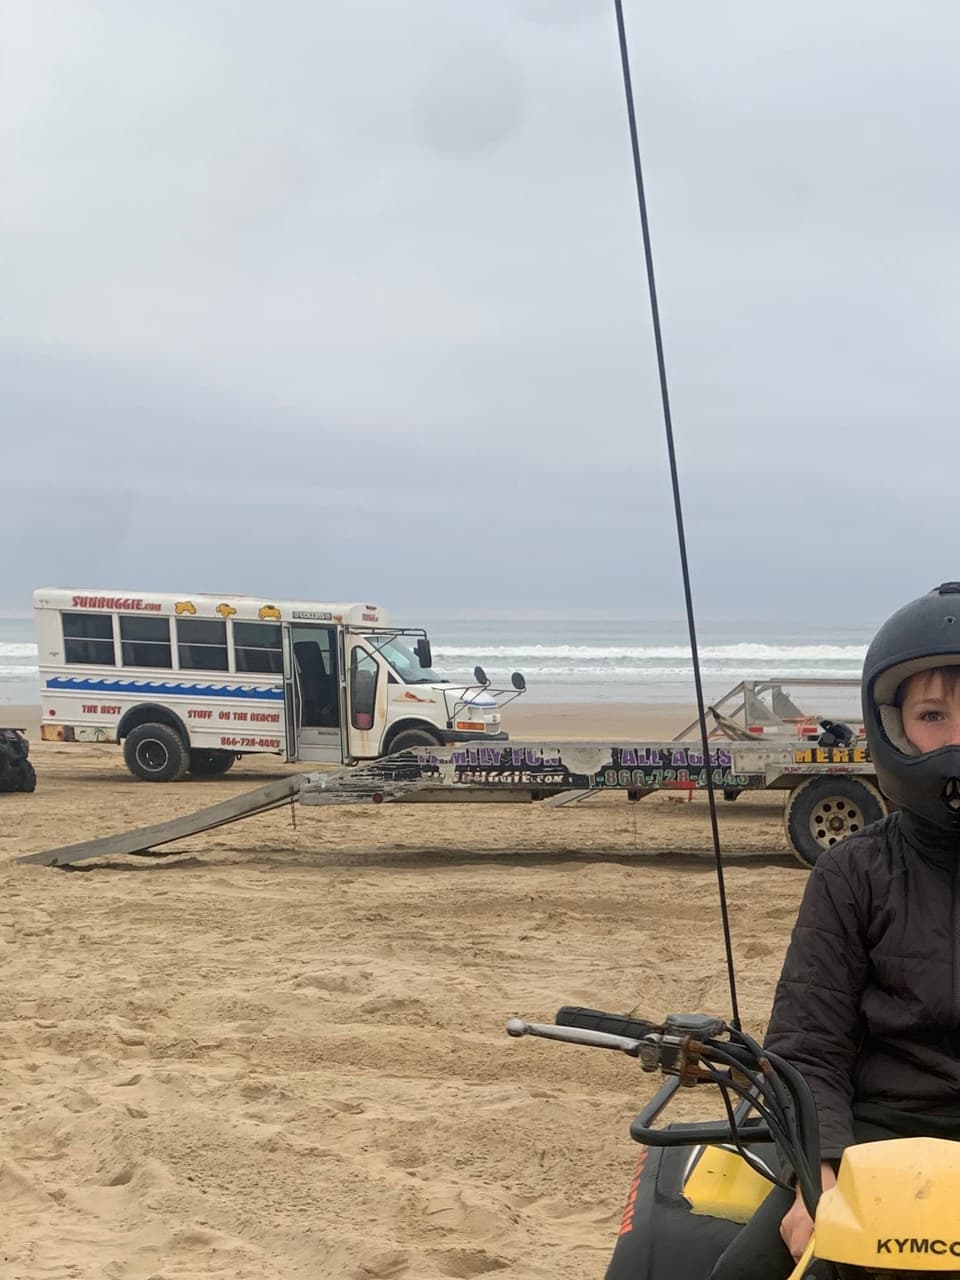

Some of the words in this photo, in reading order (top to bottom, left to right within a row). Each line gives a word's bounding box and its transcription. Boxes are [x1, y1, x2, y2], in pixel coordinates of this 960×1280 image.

[82, 704, 98, 713] THE
[101, 705, 122, 714] BEST
[187, 710, 213, 719] STUFF
[219, 711, 230, 720] ON
[233, 712, 248, 721] THE
